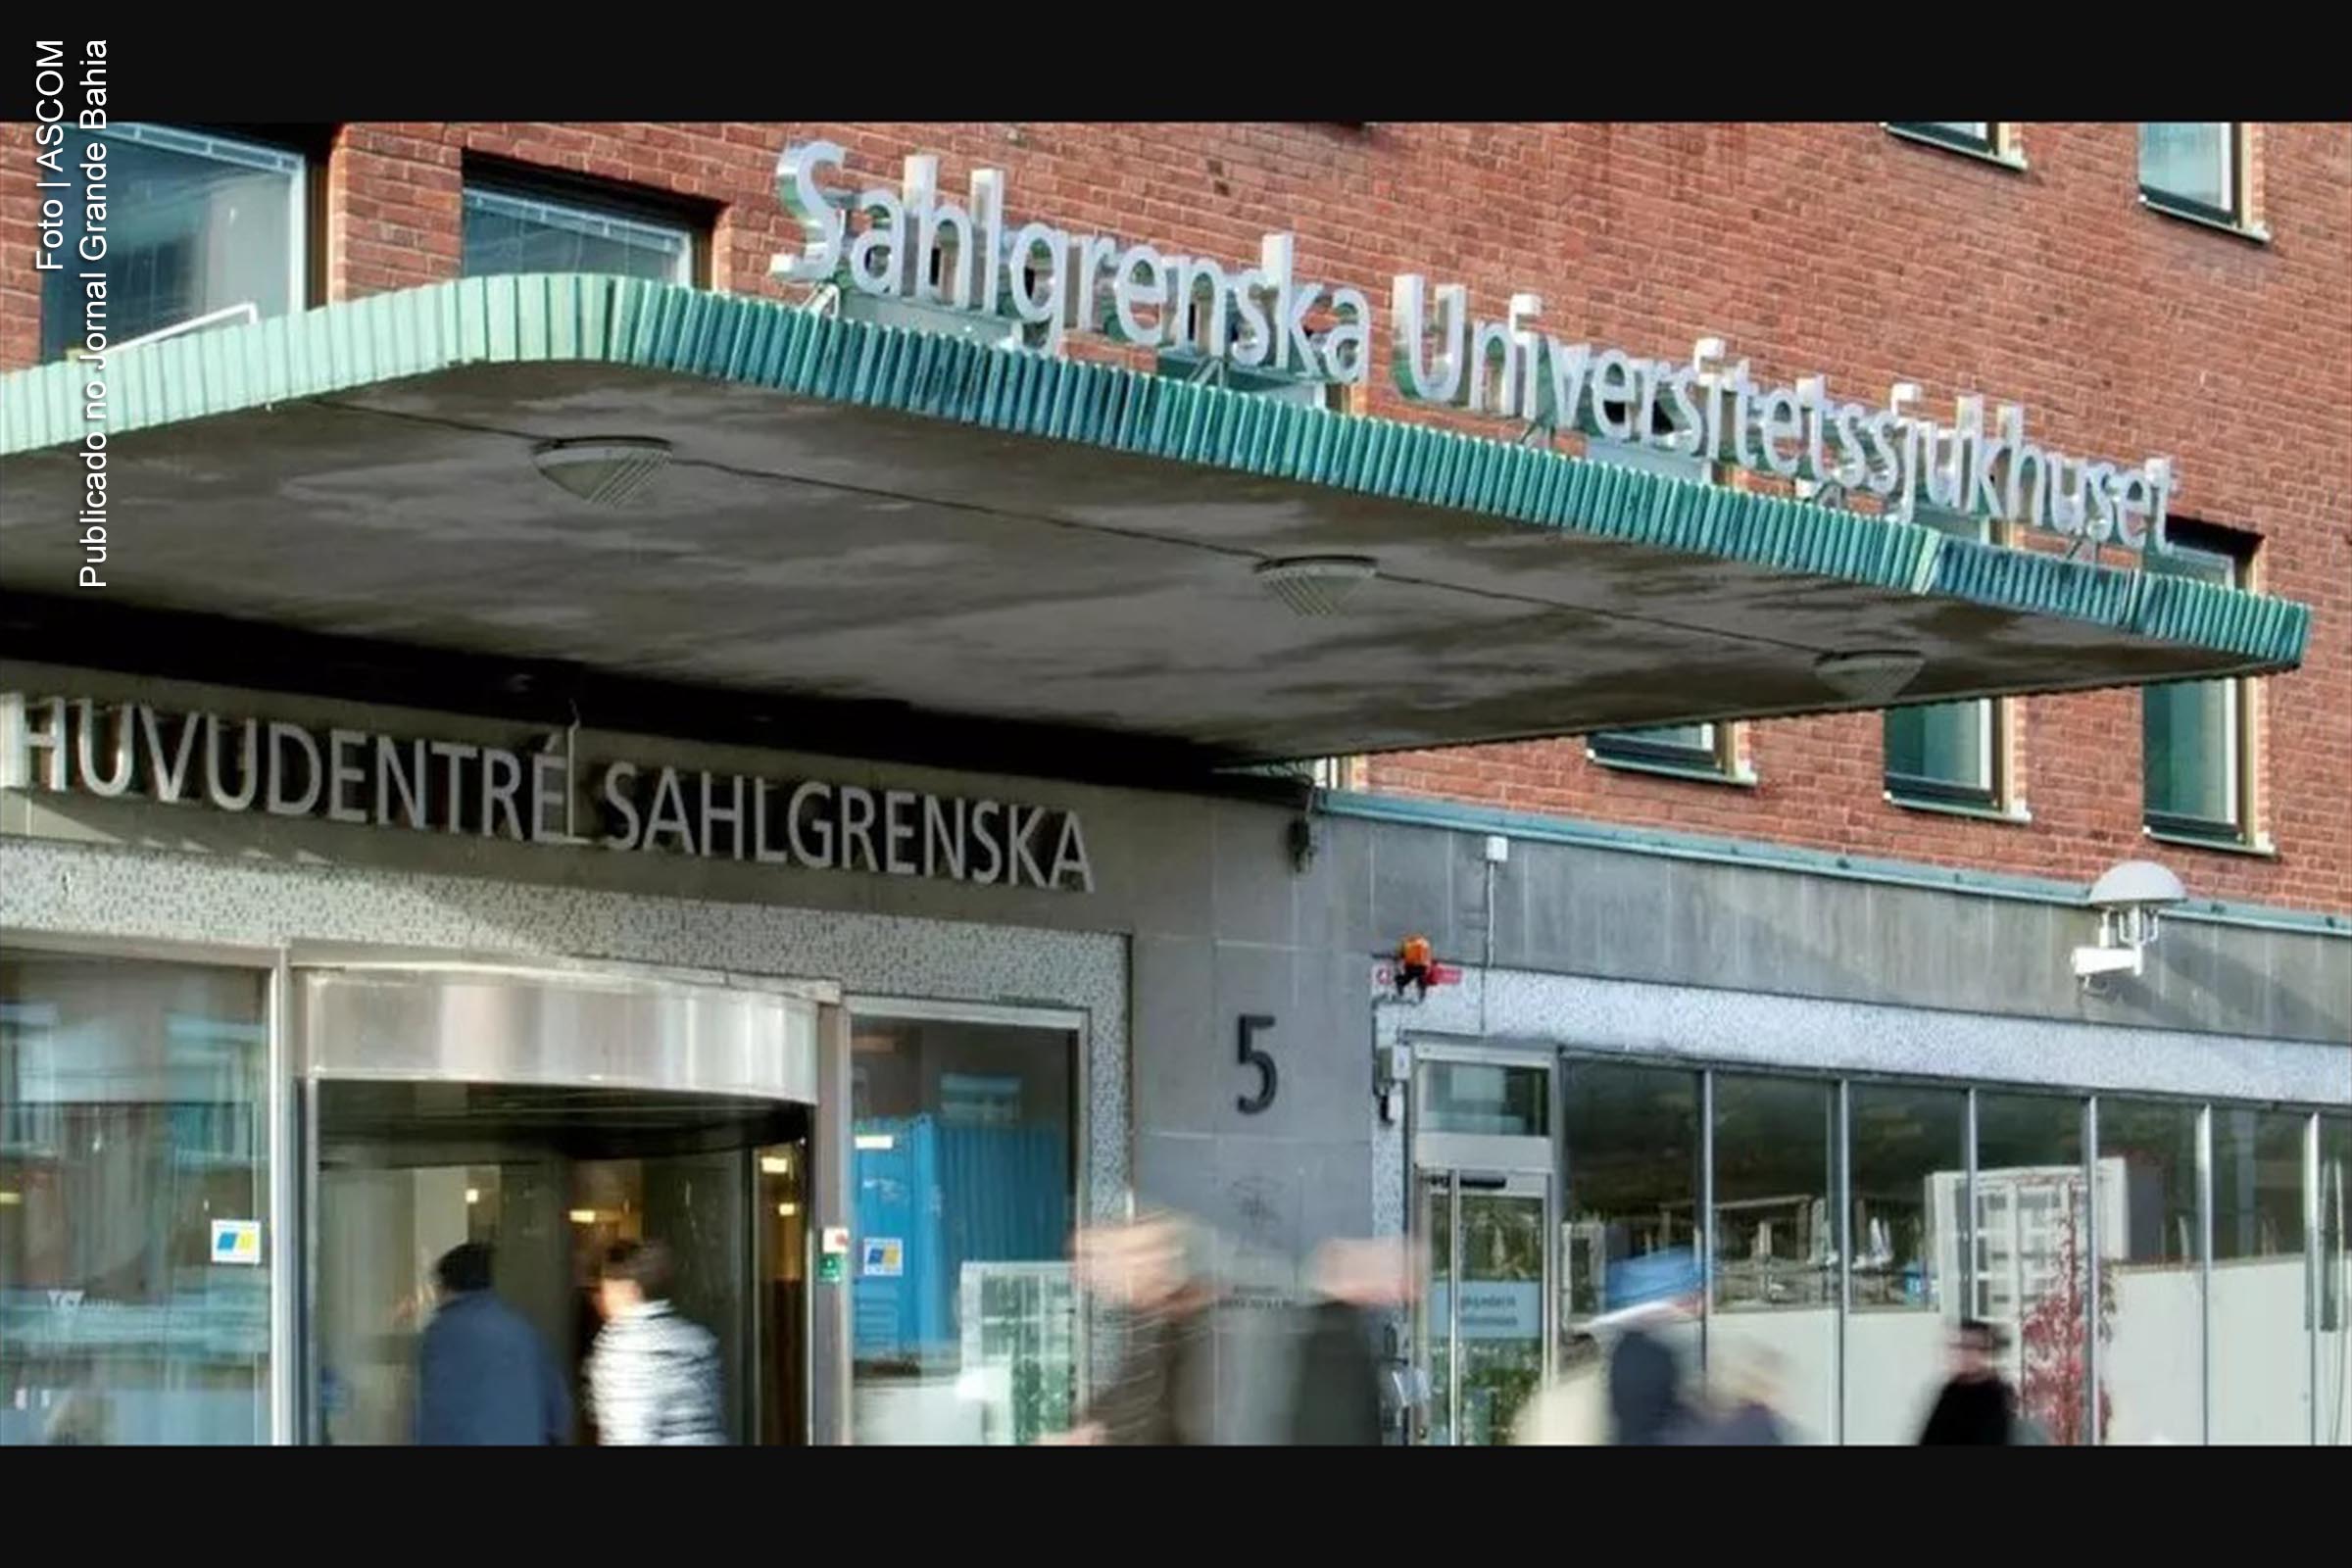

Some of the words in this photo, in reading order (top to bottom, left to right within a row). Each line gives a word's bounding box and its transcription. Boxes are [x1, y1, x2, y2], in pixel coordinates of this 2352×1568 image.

[770, 140, 1370, 384] Sahlgrenska
[1392, 273, 2176, 554] Universitetssjukhuset
[0, 693, 568, 844] HUVUDENTRÉ
[604, 760, 1095, 892] SAHLGRENSKA
[1236, 1014, 1278, 1114] 5
